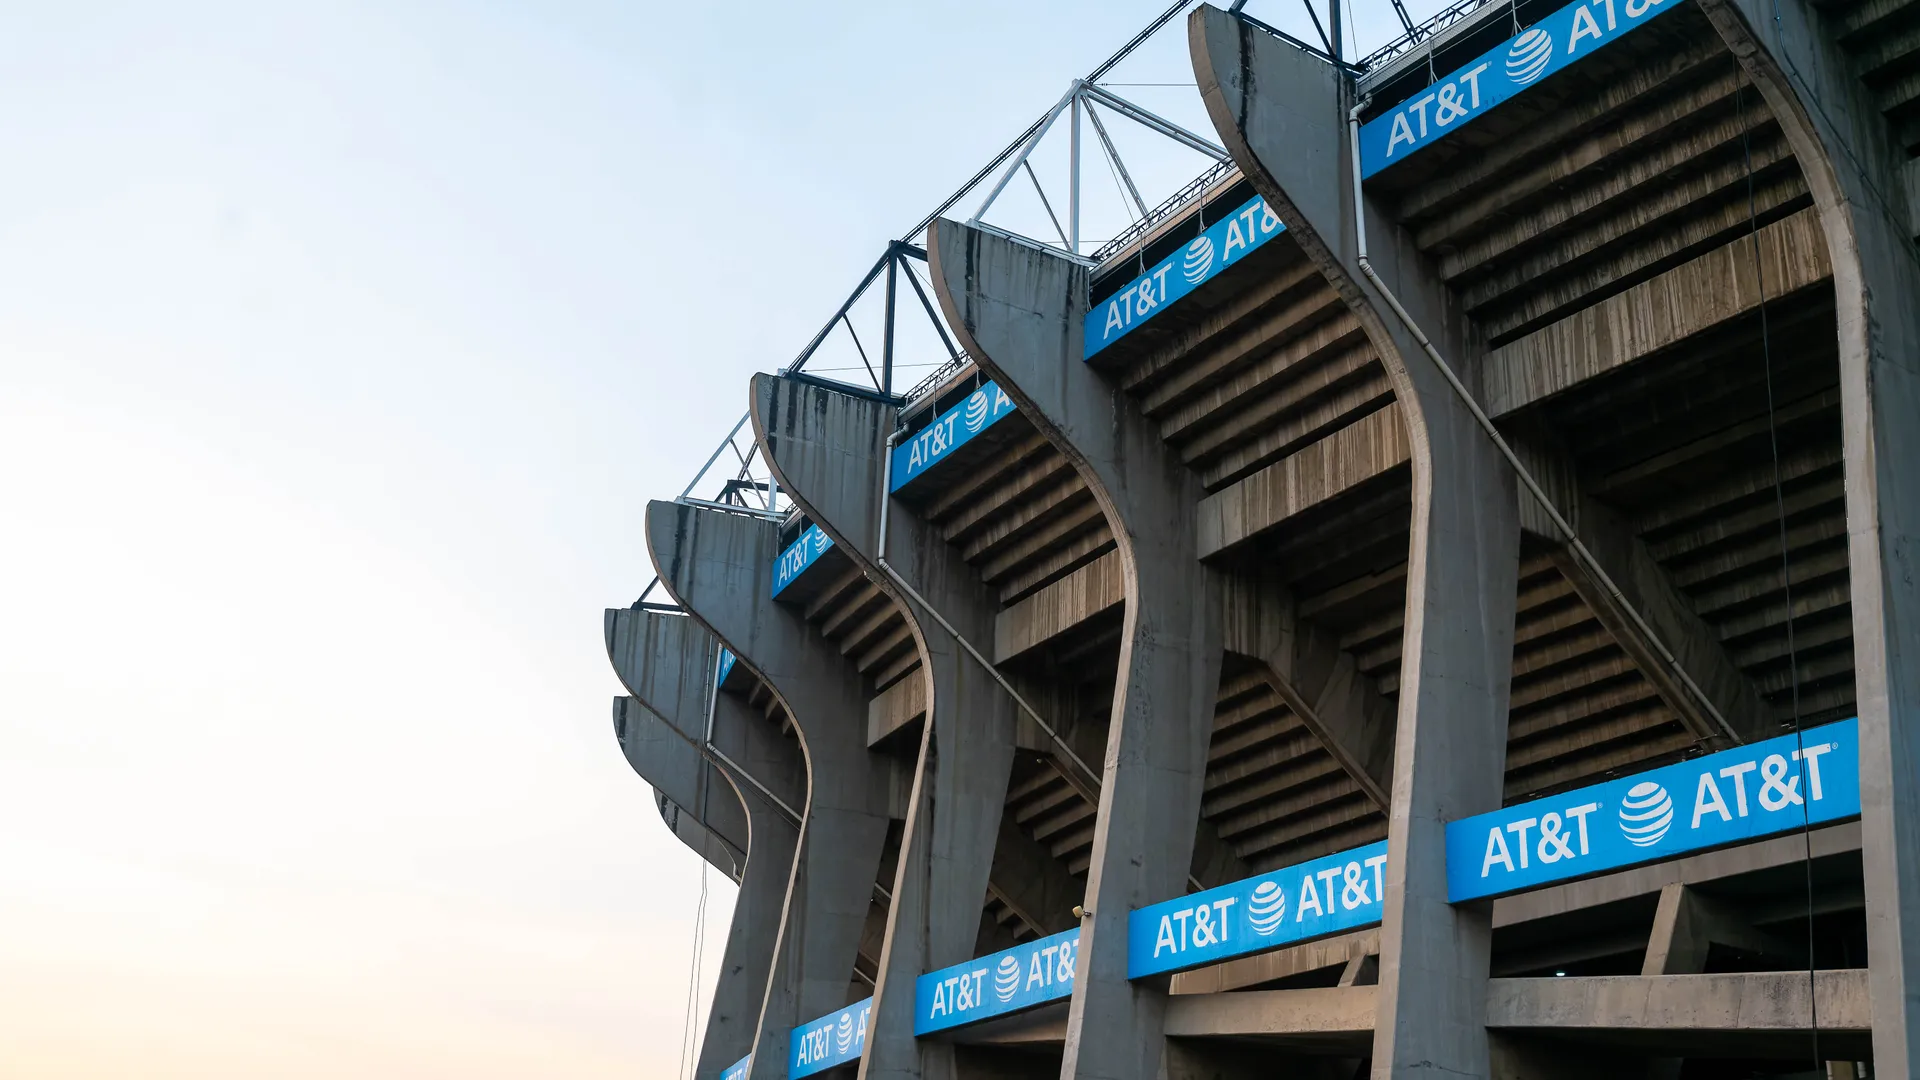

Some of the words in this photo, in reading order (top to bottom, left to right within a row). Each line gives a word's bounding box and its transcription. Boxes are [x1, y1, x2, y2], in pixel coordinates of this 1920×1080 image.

[1386, 62, 1488, 158] AT&T
[1103, 262, 1172, 340] AT&T
[907, 411, 959, 475] AT&T
[777, 533, 812, 588] AT&T
[1480, 802, 1597, 878] AT&T
[1153, 896, 1235, 958] AT&T
[1296, 854, 1387, 922] AT&T
[930, 967, 987, 1020] AT&T
[1026, 939, 1079, 992] AT&
[796, 1023, 834, 1067] AT&T
[855, 1007, 871, 1045] A
